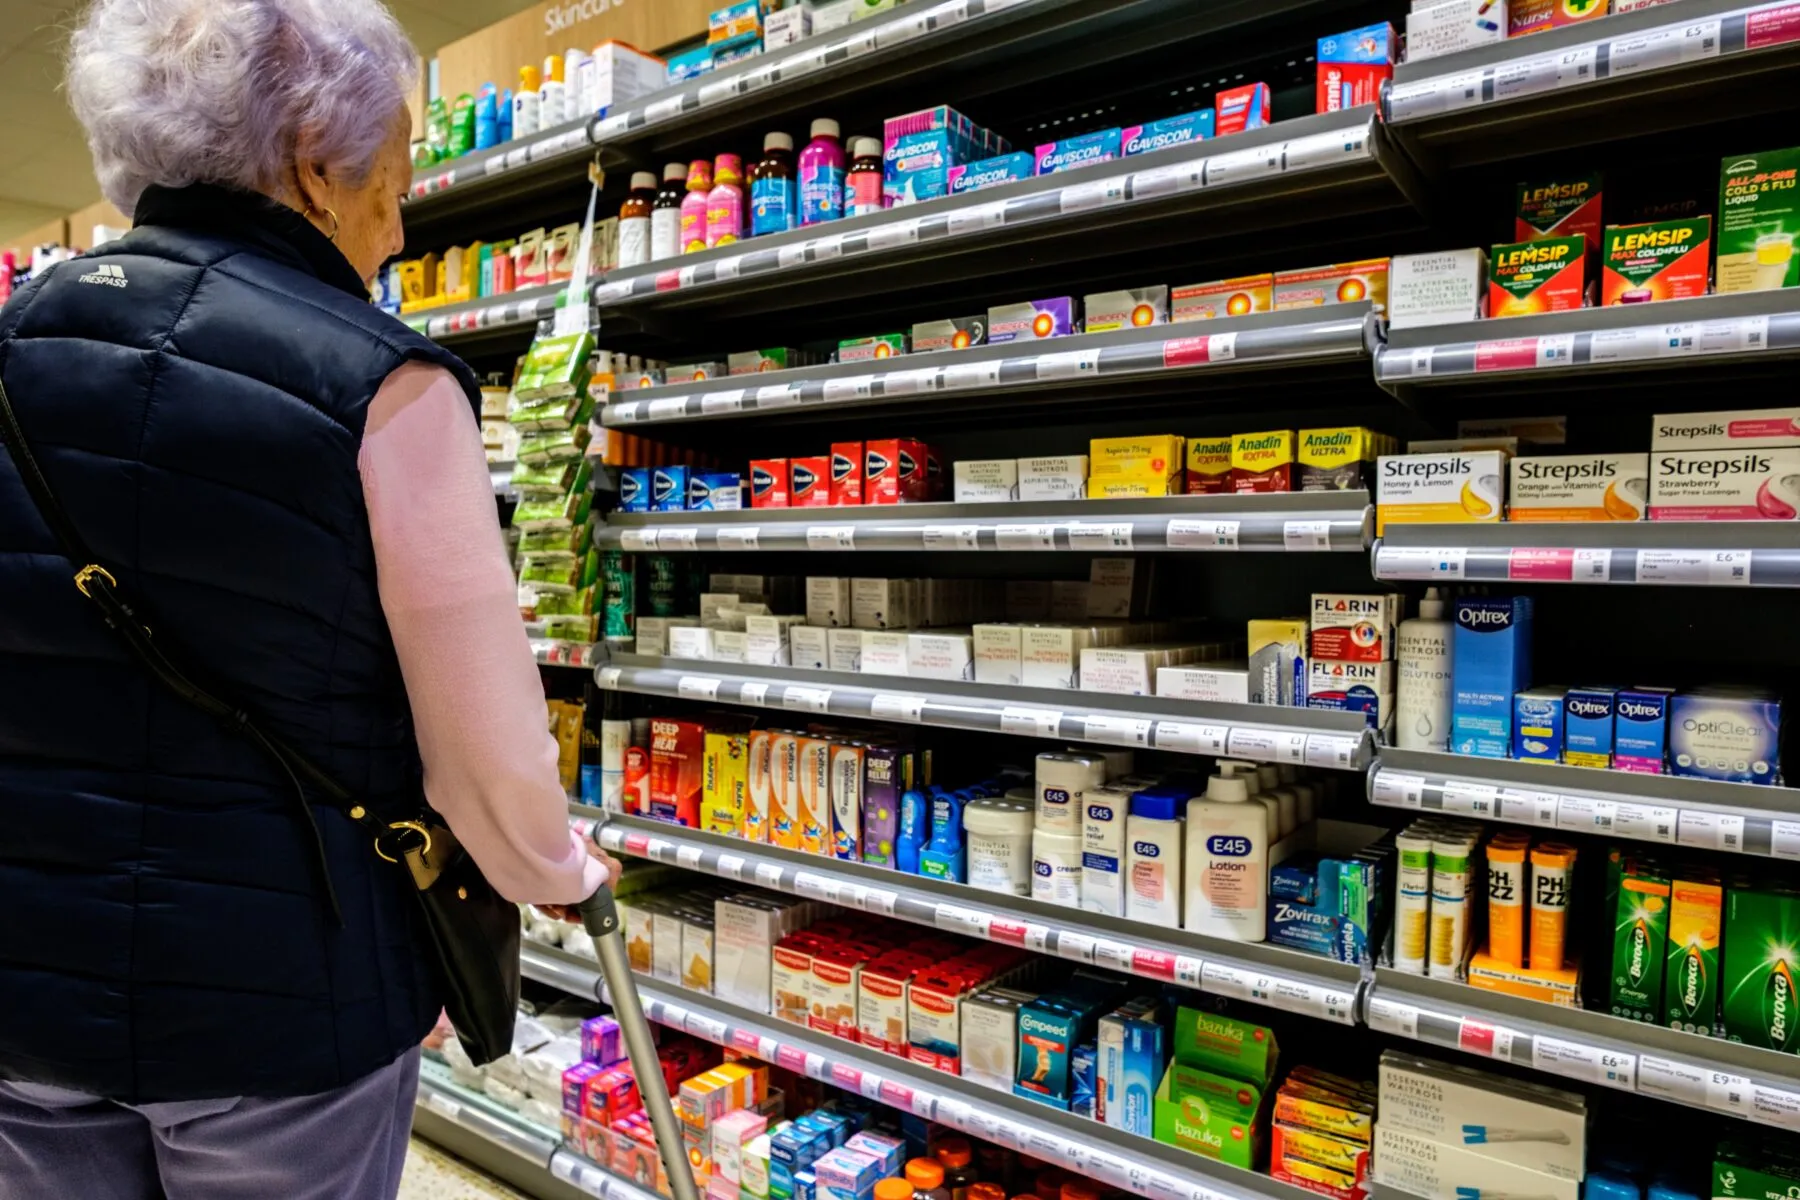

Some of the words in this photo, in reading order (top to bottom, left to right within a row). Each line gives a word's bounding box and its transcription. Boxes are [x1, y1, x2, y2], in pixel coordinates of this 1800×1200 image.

[1513, 10, 1553, 26] Nurse
[1324, 71, 1342, 113] ennie
[1127, 127, 1192, 153] GAVISCON
[886, 140, 938, 161] GAVISCON
[1042, 145, 1102, 168] GAVISCON
[954, 168, 1008, 190] GAVISCON
[1523, 182, 1589, 204] LEMSIP
[1725, 184, 1758, 198] COLD
[1760, 183, 1770, 192] &
[1772, 178, 1796, 190] FLU
[1725, 193, 1760, 206] LIQUID
[1612, 228, 1694, 252] LEMSIP
[1412, 256, 1457, 268] ESSENTIAL
[1497, 244, 1570, 268] LEMSIP
[1610, 250, 1637, 261] MAX
[1412, 263, 1457, 274] WAITROSE
[1496, 266, 1519, 277] MAX
[78, 274, 128, 288] TRESPASS
[1660, 424, 1724, 439] Strepsils
[1238, 437, 1282, 452] Anadin
[1304, 433, 1352, 447] Anadin
[1104, 446, 1130, 455] Aspirin
[1242, 450, 1276, 462] EXTRA
[1310, 446, 1346, 456] ULTRA
[1197, 455, 1230, 464] EXTRA
[1660, 454, 1771, 479] Strepsils
[1384, 457, 1472, 479] Strepsils
[1518, 460, 1616, 482] Strepsils
[1102, 484, 1128, 494] Aspirin
[1384, 480, 1412, 488] Honey
[1422, 478, 1454, 487] Lemon
[1518, 482, 1550, 492] Orange
[1562, 481, 1598, 490] Vitamin
[1658, 480, 1720, 489] Strawberry
[1716, 552, 1734, 562] £6
[1458, 608, 1510, 626] Optrex
[1568, 700, 1609, 715] Optrex
[1618, 702, 1660, 718] Optrex
[652, 721, 680, 735] DEEP
[1682, 718, 1764, 736] OptiClear
[652, 738, 678, 752] HEAT
[786, 741, 796, 783] Voltarol
[816, 746, 826, 788] Voltarol
[868, 758, 892, 769] DEEP
[1046, 790, 1066, 802] E45
[1090, 808, 1110, 820] E45
[1136, 842, 1157, 856] E45
[1213, 840, 1247, 854] E45
[1034, 862, 1049, 876] E45
[1056, 864, 1082, 874] cream
[1208, 860, 1246, 872] Lotion
[1536, 875, 1564, 892] PH
[1489, 886, 1514, 901] ZZ
[1274, 904, 1330, 926] Zovirax
[1630, 928, 1645, 978] Berocca
[1684, 956, 1698, 1007] Berocca
[1325, 994, 1338, 1004] £6
[1770, 974, 1788, 1041] Berocca
[1020, 1014, 1068, 1038] Compeed
[1196, 1014, 1244, 1042] bazuka
[1602, 1056, 1618, 1068] £6
[1386, 1072, 1442, 1094] ESSENTIAL
[1712, 1074, 1729, 1085] £9
[1387, 1080, 1443, 1102] WAITROSE
[1384, 1094, 1440, 1113] PREGNANCY
[1408, 1108, 1430, 1120] TEST
[1432, 1115, 1445, 1124] KIT
[1174, 1119, 1223, 1148] bazuka
[1382, 1130, 1438, 1154] ESSENTIAL
[1382, 1140, 1438, 1162] WAITROSE
[1380, 1152, 1435, 1174] PREGNANCY
[1404, 1168, 1424, 1180] TEST
[1426, 1175, 1440, 1184] KIT
